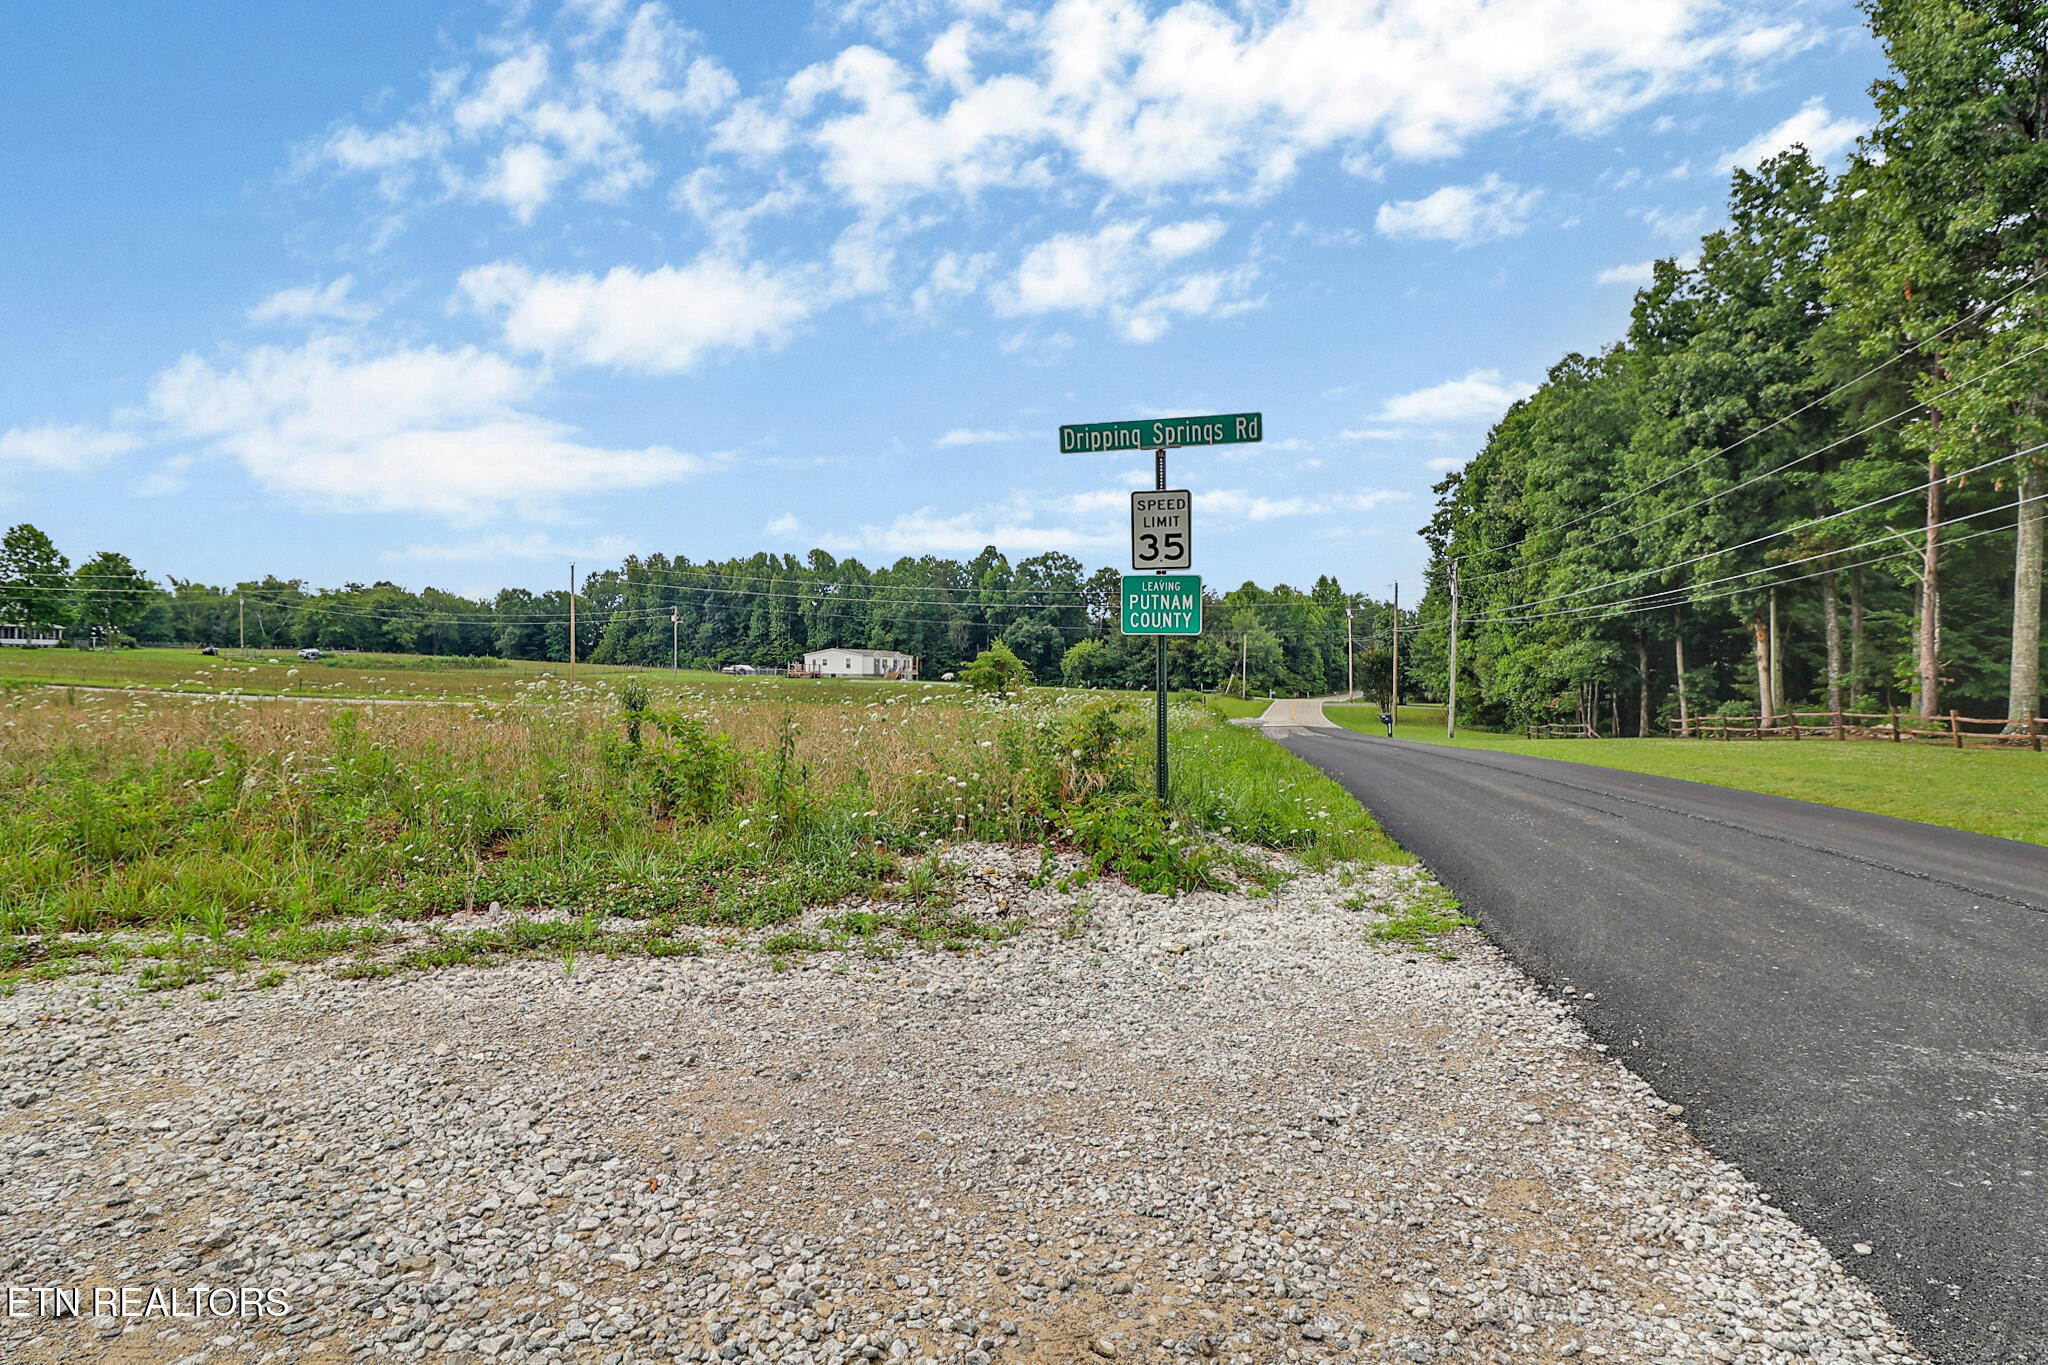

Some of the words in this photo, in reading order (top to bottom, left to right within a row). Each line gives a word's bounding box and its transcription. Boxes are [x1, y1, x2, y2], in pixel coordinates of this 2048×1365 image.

[1063, 425, 1141, 451] Dripping
[1152, 420, 1223, 446] Springs
[1235, 416, 1258, 440] Rd
[1137, 498, 1186, 511] SPEED
[1143, 515, 1180, 528] LIMIT
[1138, 532, 1185, 561] 35
[1142, 581, 1181, 591] LEAVING
[1129, 594, 1193, 610] PUTNAM
[1130, 612, 1192, 628] COUNTY
